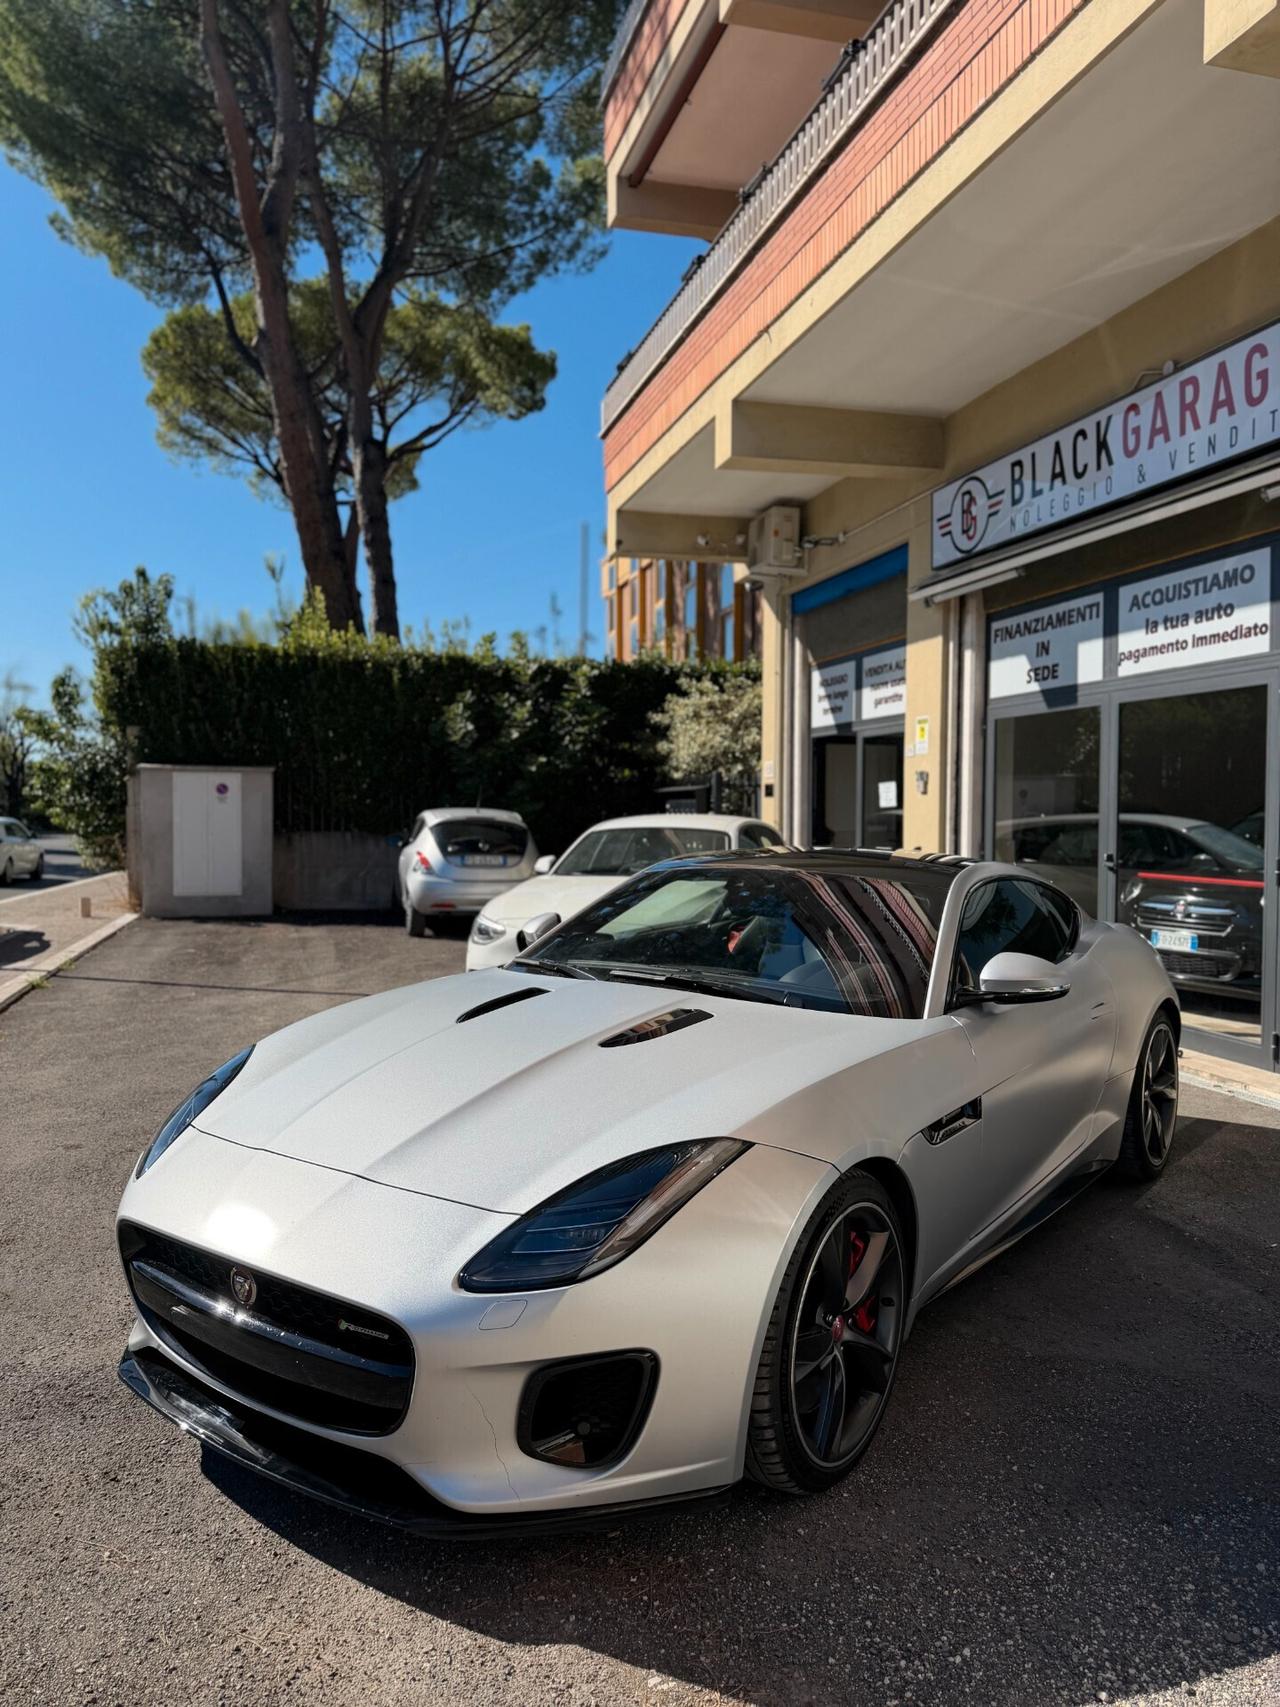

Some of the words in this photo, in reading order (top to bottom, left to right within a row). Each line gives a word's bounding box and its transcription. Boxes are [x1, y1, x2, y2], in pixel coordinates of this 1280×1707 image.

[1010, 475, 1113, 533] NOLEGGIO
[1137, 464, 1147, 483] &
[1168, 408, 1278, 472] VENDIT
[1129, 564, 1256, 613] ACQUISTIAMO
[993, 602, 1101, 644] FINANZIAMENTI
[1144, 617, 1159, 635] la
[1163, 614, 1189, 632] tua
[1194, 602, 1235, 624] auto
[1035, 640, 1050, 658] IN
[1118, 639, 1188, 666] pagamento
[1192, 621, 1269, 648] immediato
[1026, 663, 1060, 685] SEDE
